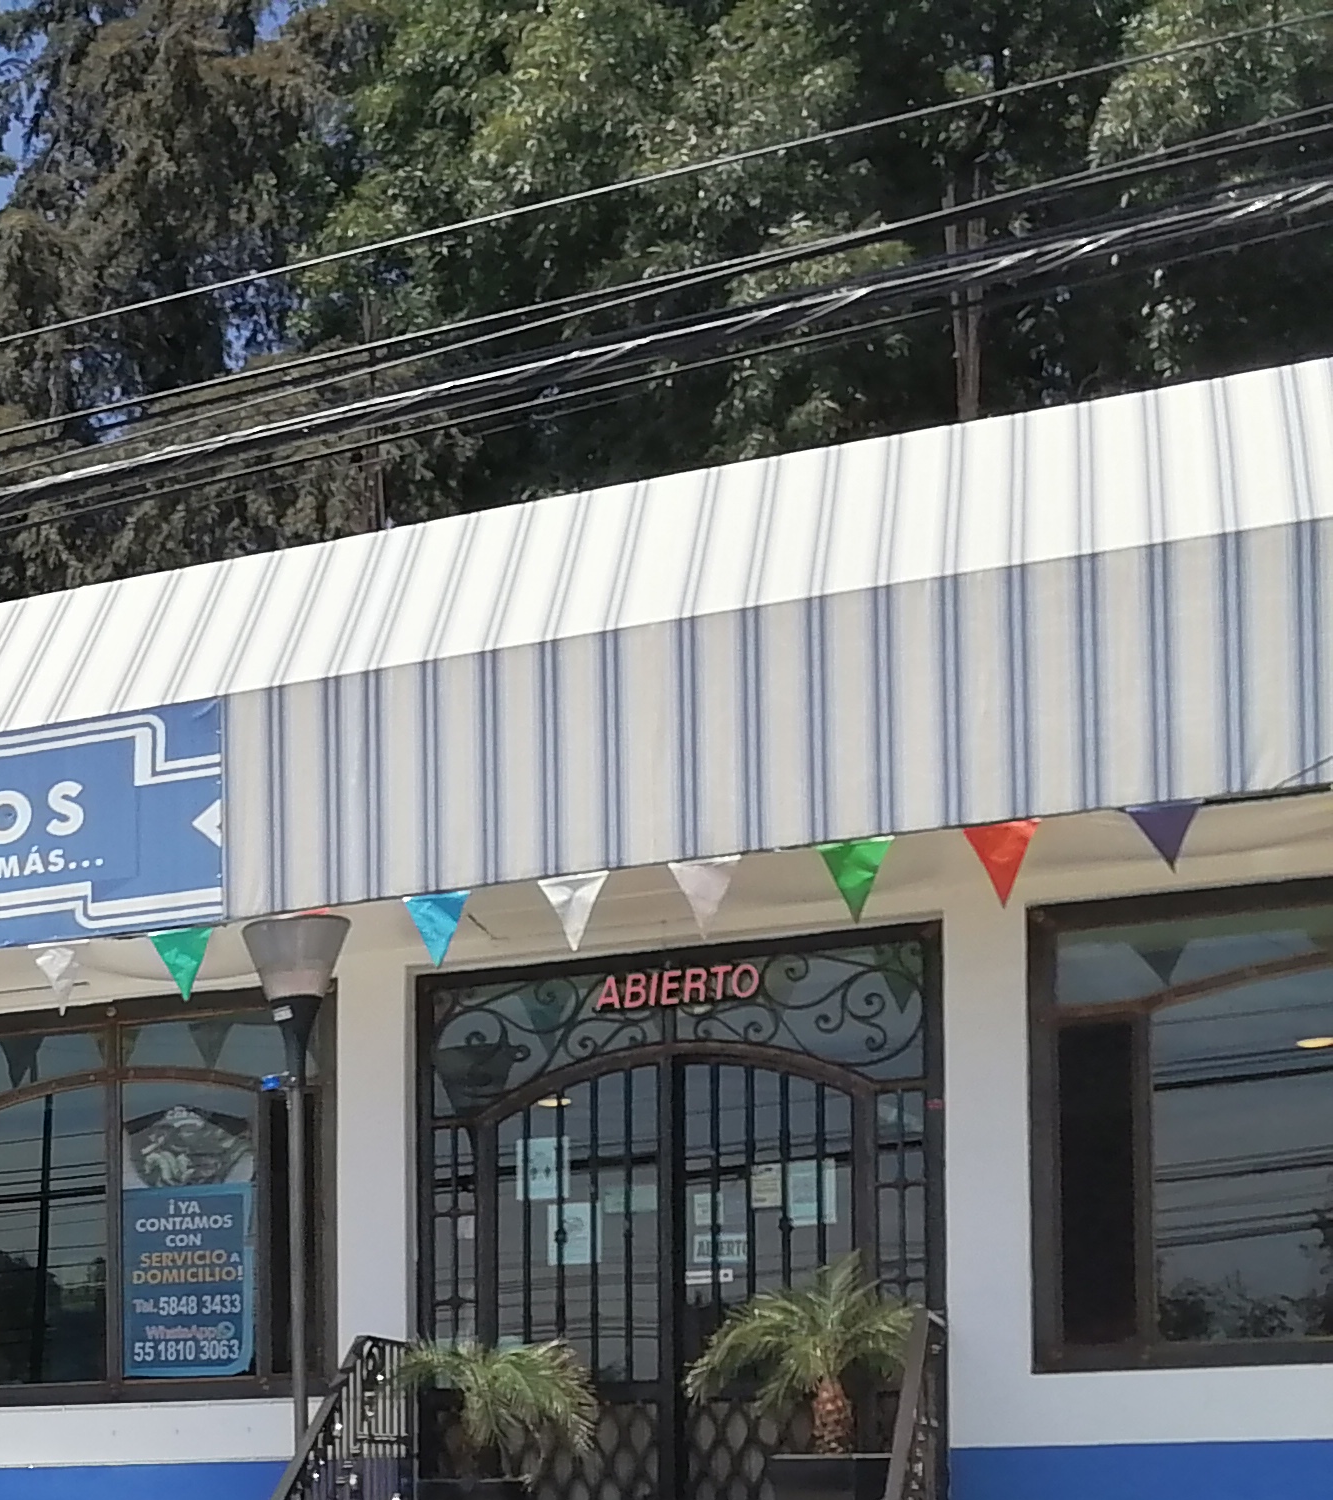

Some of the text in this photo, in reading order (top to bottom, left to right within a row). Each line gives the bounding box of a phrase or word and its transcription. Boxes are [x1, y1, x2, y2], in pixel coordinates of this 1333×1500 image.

[596, 963, 759, 1011] ABIERTO
[135, 1214, 233, 1232] CONTAMOS
[165, 1233, 202, 1247] CON
[140, 1249, 240, 1267] SERVICIO A
[132, 1265, 244, 1285] DOMICILIO!
[159, 1295, 198, 1315] 5848
[202, 1294, 241, 1314] 3433
[133, 1340, 240, 1361] 55 1810 3063
